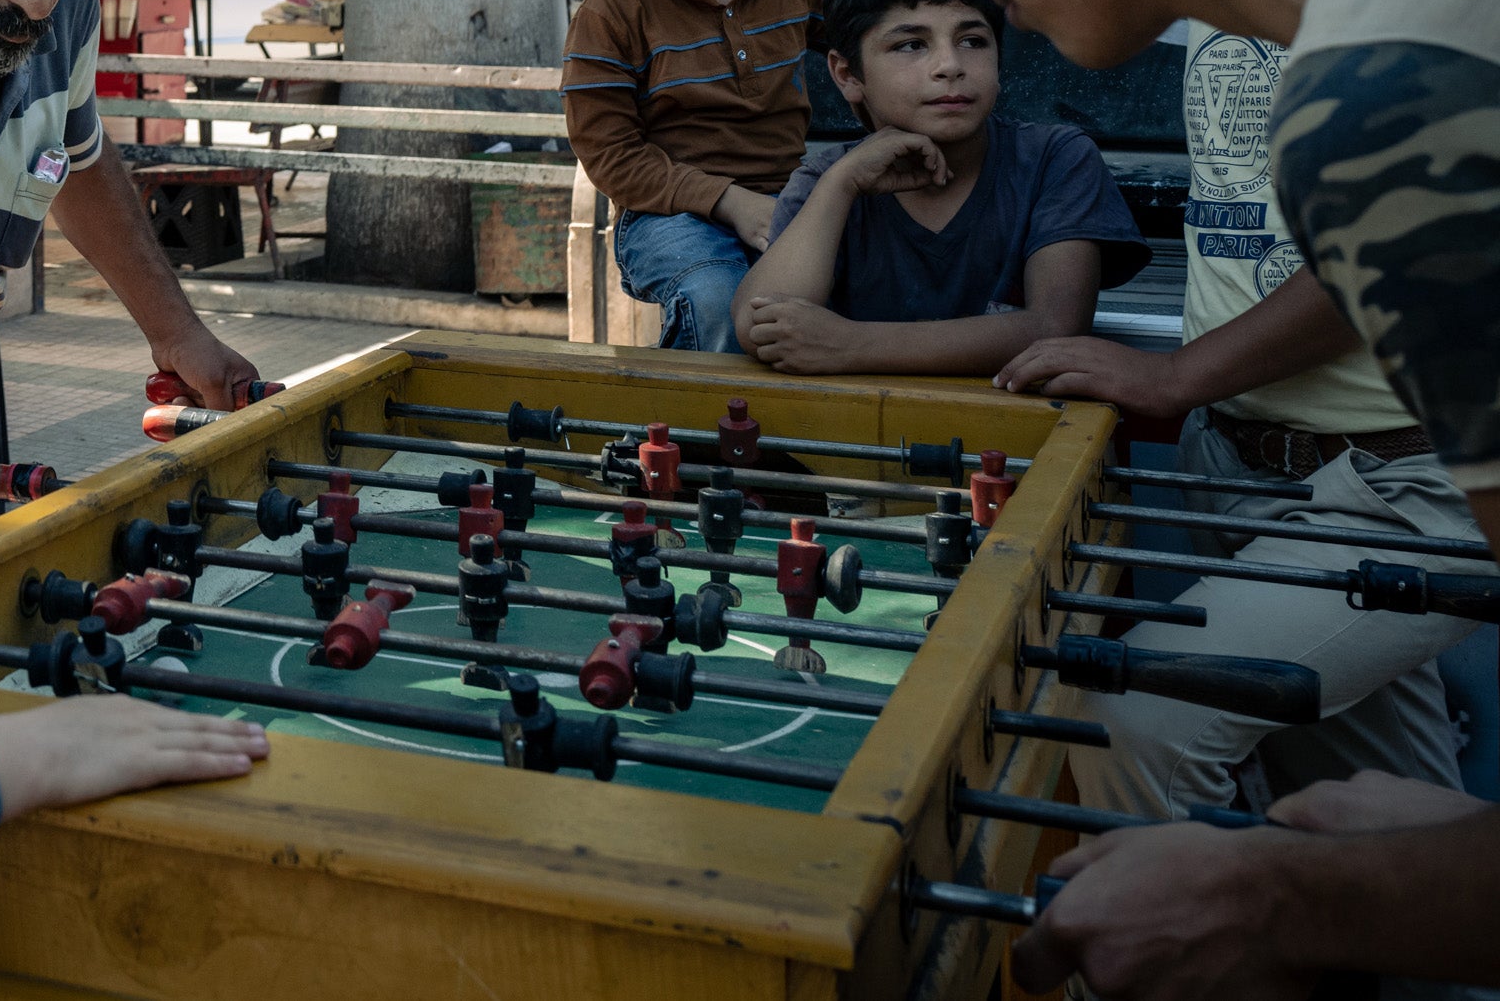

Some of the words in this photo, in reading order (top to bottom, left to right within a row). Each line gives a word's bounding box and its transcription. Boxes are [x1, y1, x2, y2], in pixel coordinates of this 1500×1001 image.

[1209, 50, 1229, 59] PARIS
[1231, 48, 1248, 58] LOUIS
[1202, 234, 1265, 259] PARIS
